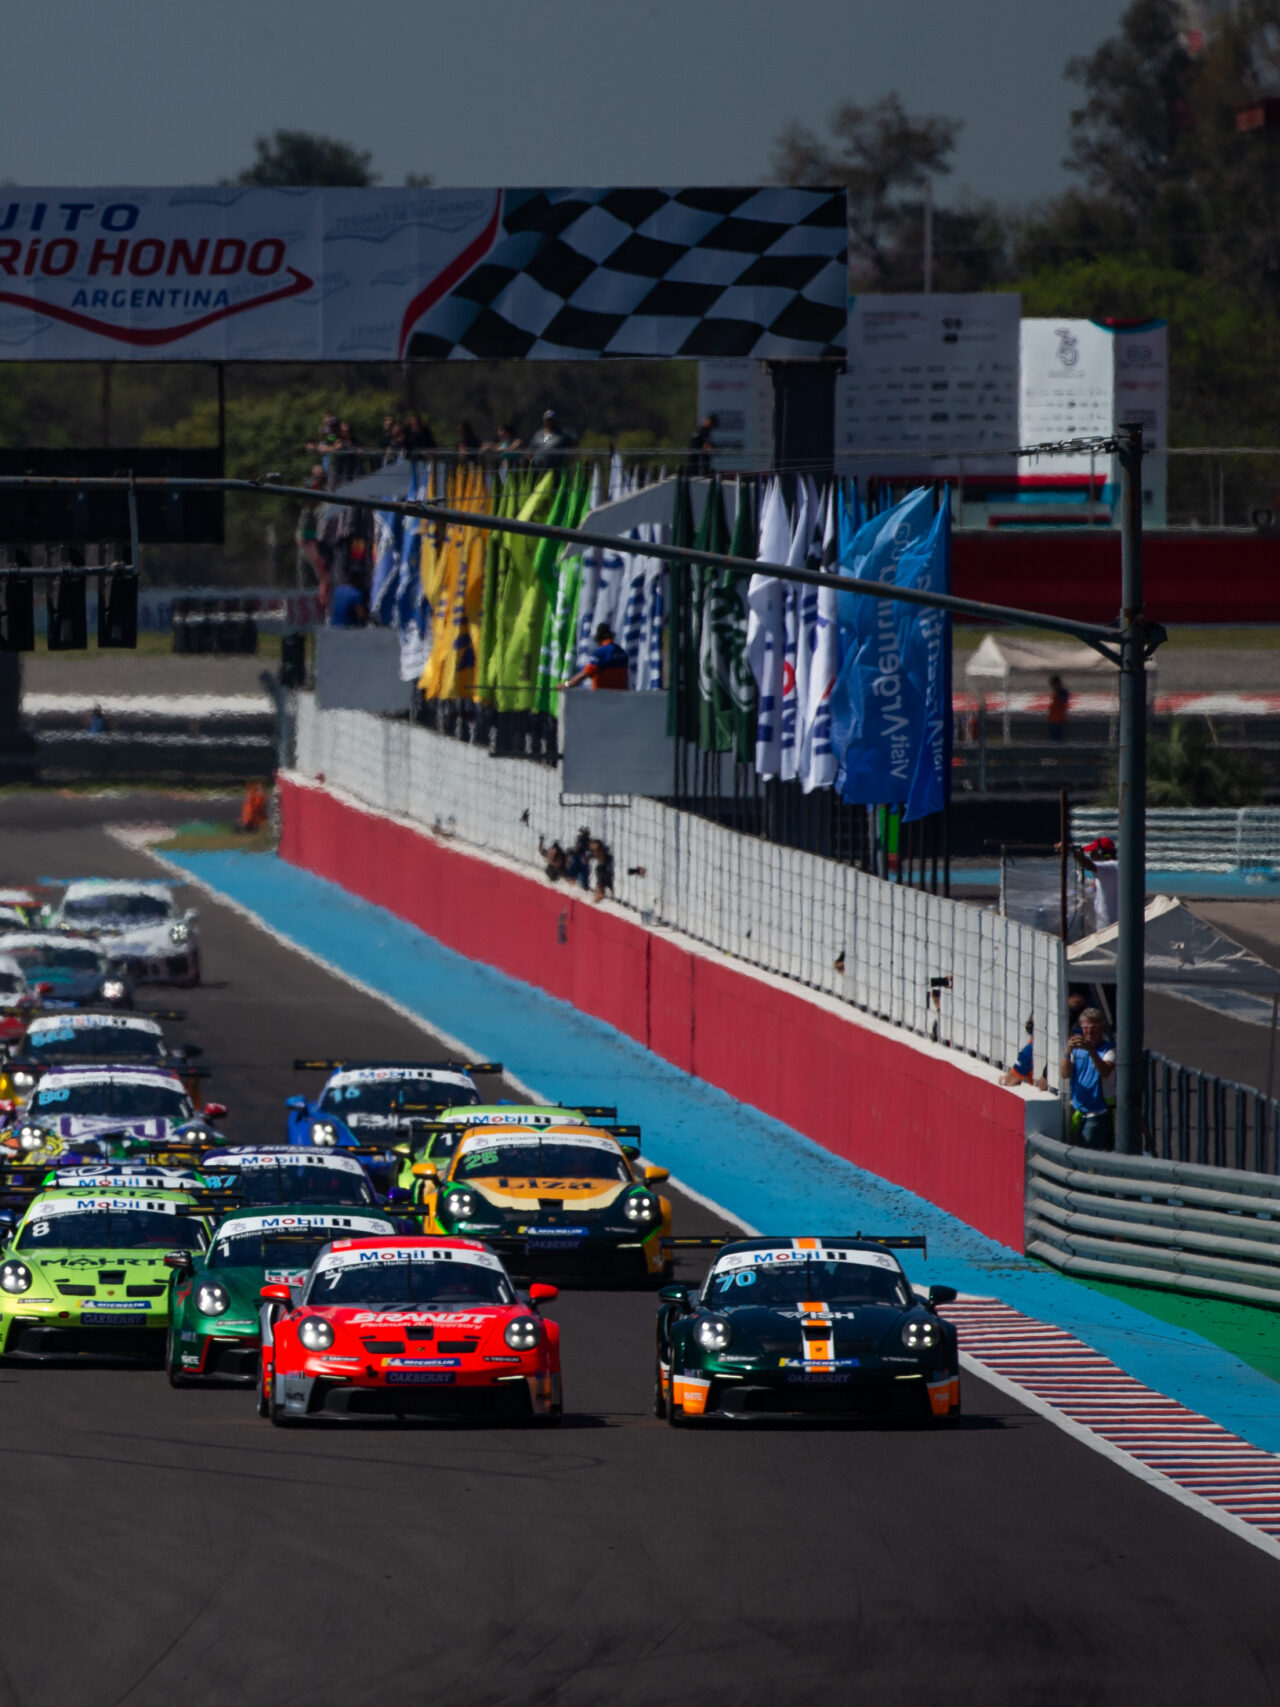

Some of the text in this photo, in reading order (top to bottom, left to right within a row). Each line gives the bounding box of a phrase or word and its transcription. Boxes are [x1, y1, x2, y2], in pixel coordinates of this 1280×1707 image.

[88, 238, 286, 276] HONDO
[72, 288, 229, 308] ARGENTINA
[473, 1115, 529, 1125] Mobil
[241, 1156, 299, 1165] Mobil
[79, 1178, 139, 1187] Mobil
[78, 1200, 140, 1209] Mobil
[262, 1217, 324, 1227] Mobil
[31, 1221, 51, 1238] 8
[216, 1242, 231, 1258] 1
[359, 1250, 425, 1261] Mobil
[754, 1251, 820, 1263] Mobil
[324, 1272, 345, 1291] 7
[715, 1269, 758, 1294] 70
[82, 1313, 145, 1325] OAKBERRY
[344, 1312, 498, 1325] BRANDT
[389, 1372, 453, 1384] OAKBERRY
[787, 1373, 851, 1384] OAKBERRY
